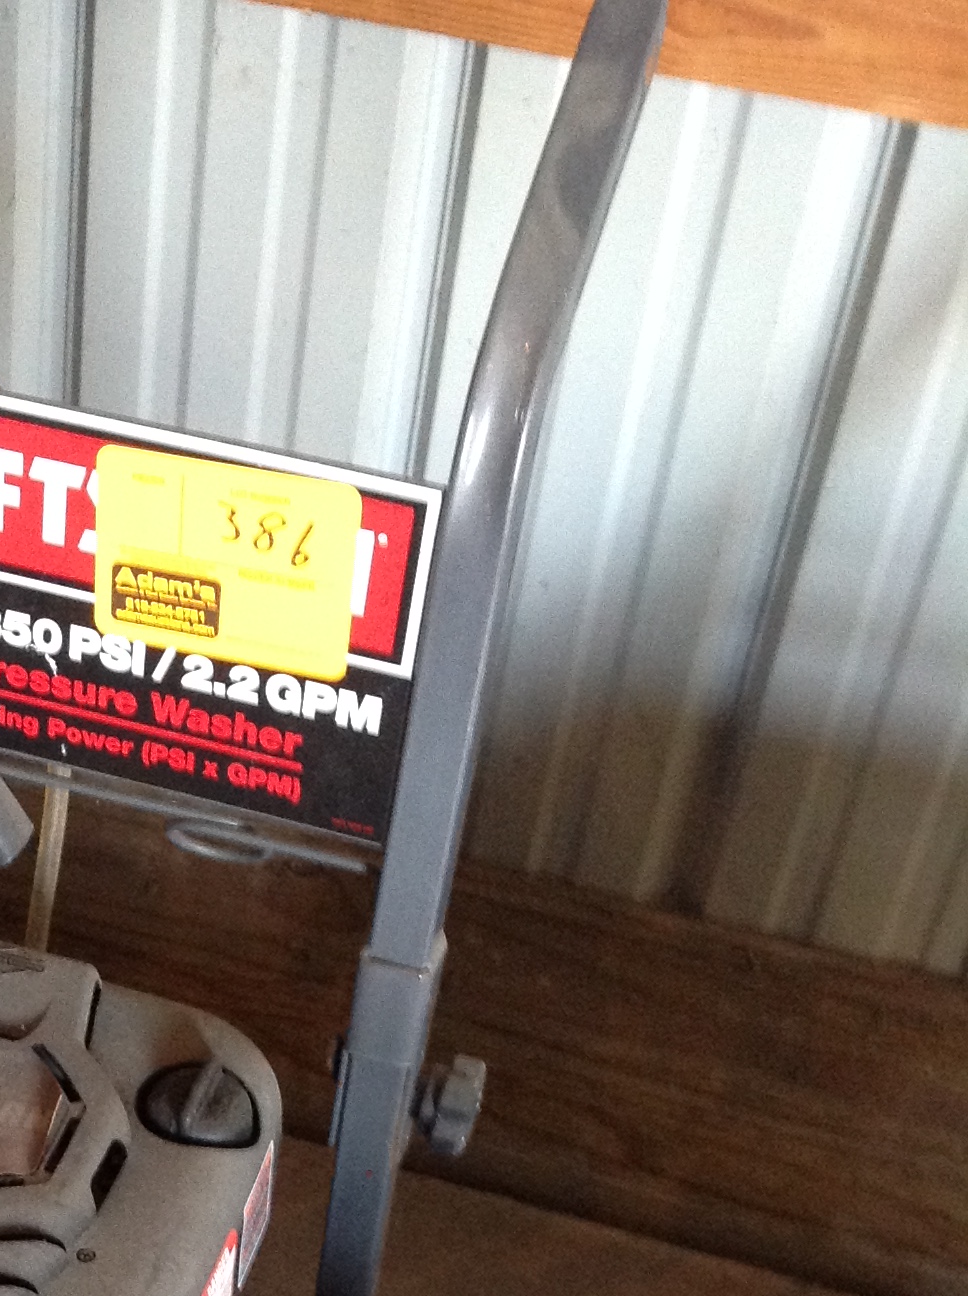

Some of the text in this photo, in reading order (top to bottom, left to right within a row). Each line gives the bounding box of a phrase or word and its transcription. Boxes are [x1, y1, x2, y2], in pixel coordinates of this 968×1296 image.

[218, 499, 314, 567] 386
[68, 623, 147, 678] PSI
[180, 653, 261, 706] 2.2
[265, 673, 383, 737] GPM
[47, 716, 134, 757] Power
[141, 740, 196, 776] (PSI
[202, 759, 219, 782] x
[227, 762, 302, 805] GPM)
[150, 691, 304, 757] Washer
